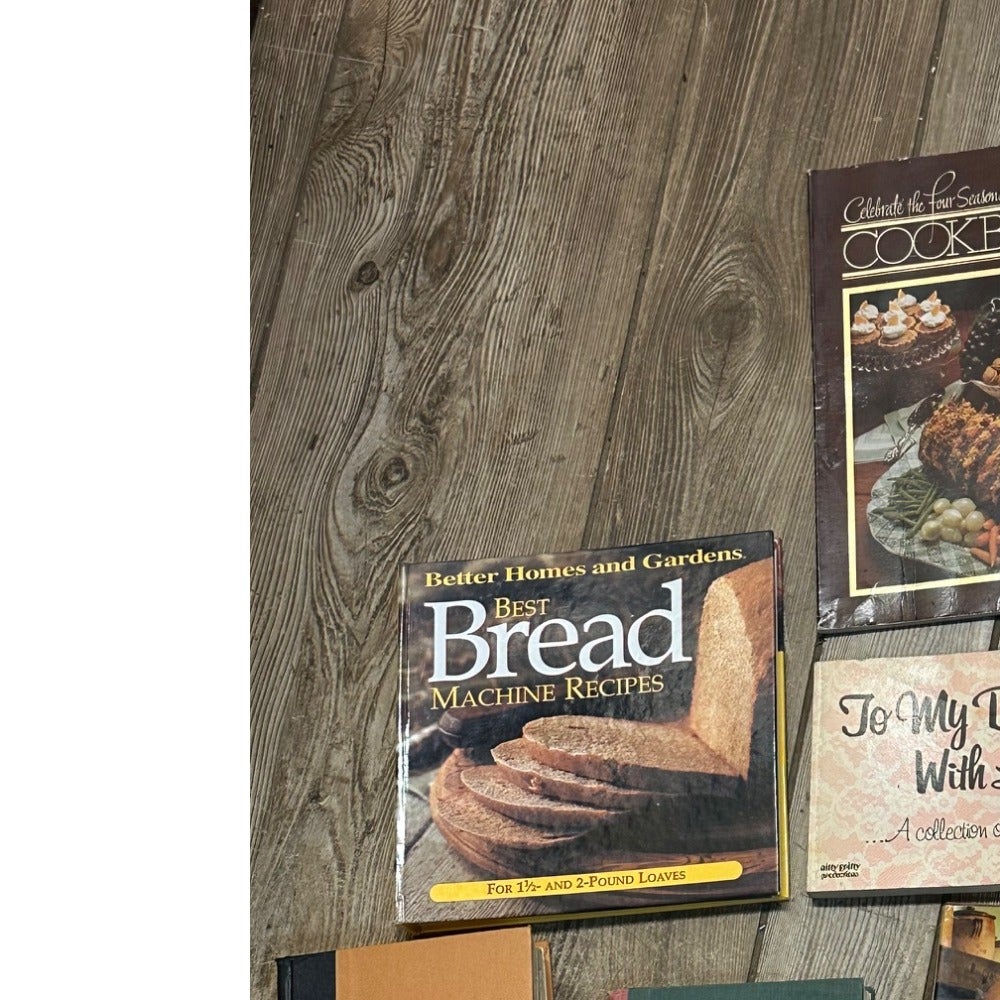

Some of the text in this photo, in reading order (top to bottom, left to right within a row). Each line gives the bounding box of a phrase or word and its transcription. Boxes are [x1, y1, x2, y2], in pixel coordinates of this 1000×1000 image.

[844, 194, 905, 223] Celebrate
[907, 190, 926, 215] the
[425, 570, 498, 588] Better
[505, 564, 587, 582] Homes
[592, 556, 636, 575] and
[424, 578, 692, 683] Bread
[430, 675, 665, 711] MACHINE RECIPES
[839, 693, 892, 737] To
[895, 690, 968, 751] My
[915, 743, 987, 794] With
[915, 818, 988, 841] collection
[545, 880, 573, 891] AND
[638, 870, 687, 884] LOAVES
